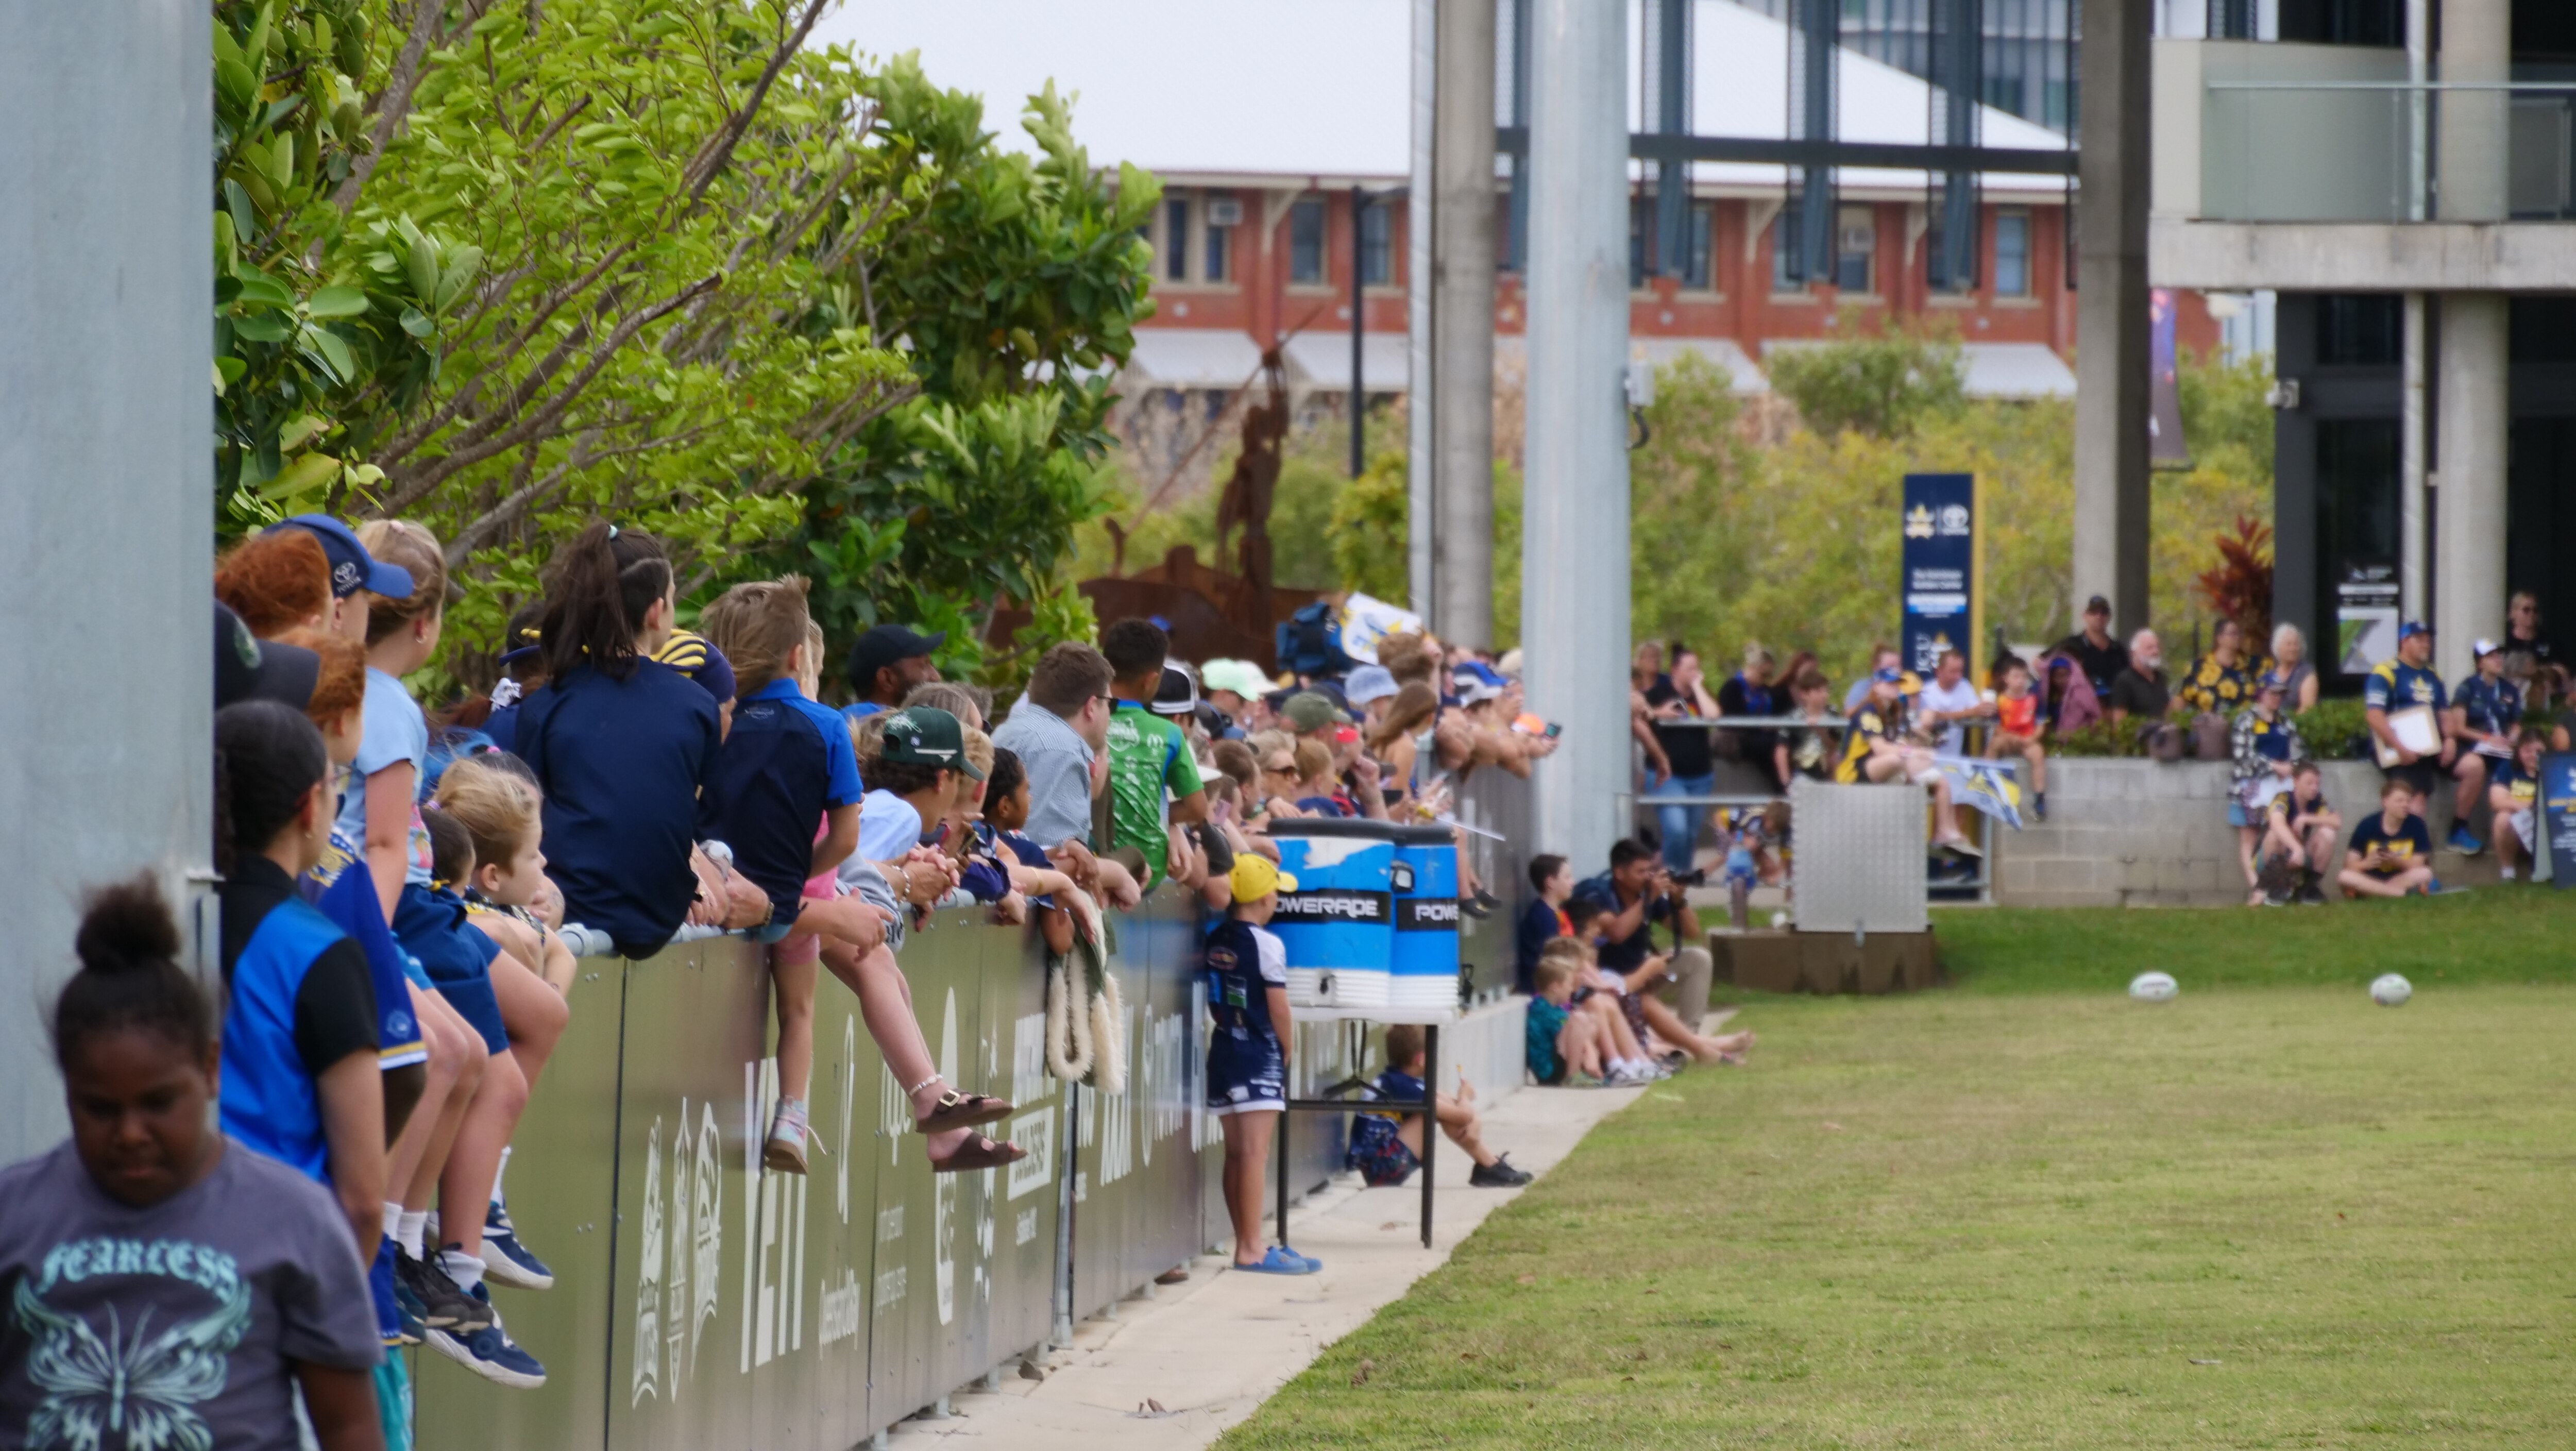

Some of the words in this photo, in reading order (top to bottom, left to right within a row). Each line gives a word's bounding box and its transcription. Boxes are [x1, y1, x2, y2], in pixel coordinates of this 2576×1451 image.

[337, 576, 362, 593] TOYOTA
[1275, 897, 1380, 918] OWERADE
[35, 1236, 239, 1306] FEARLESS
